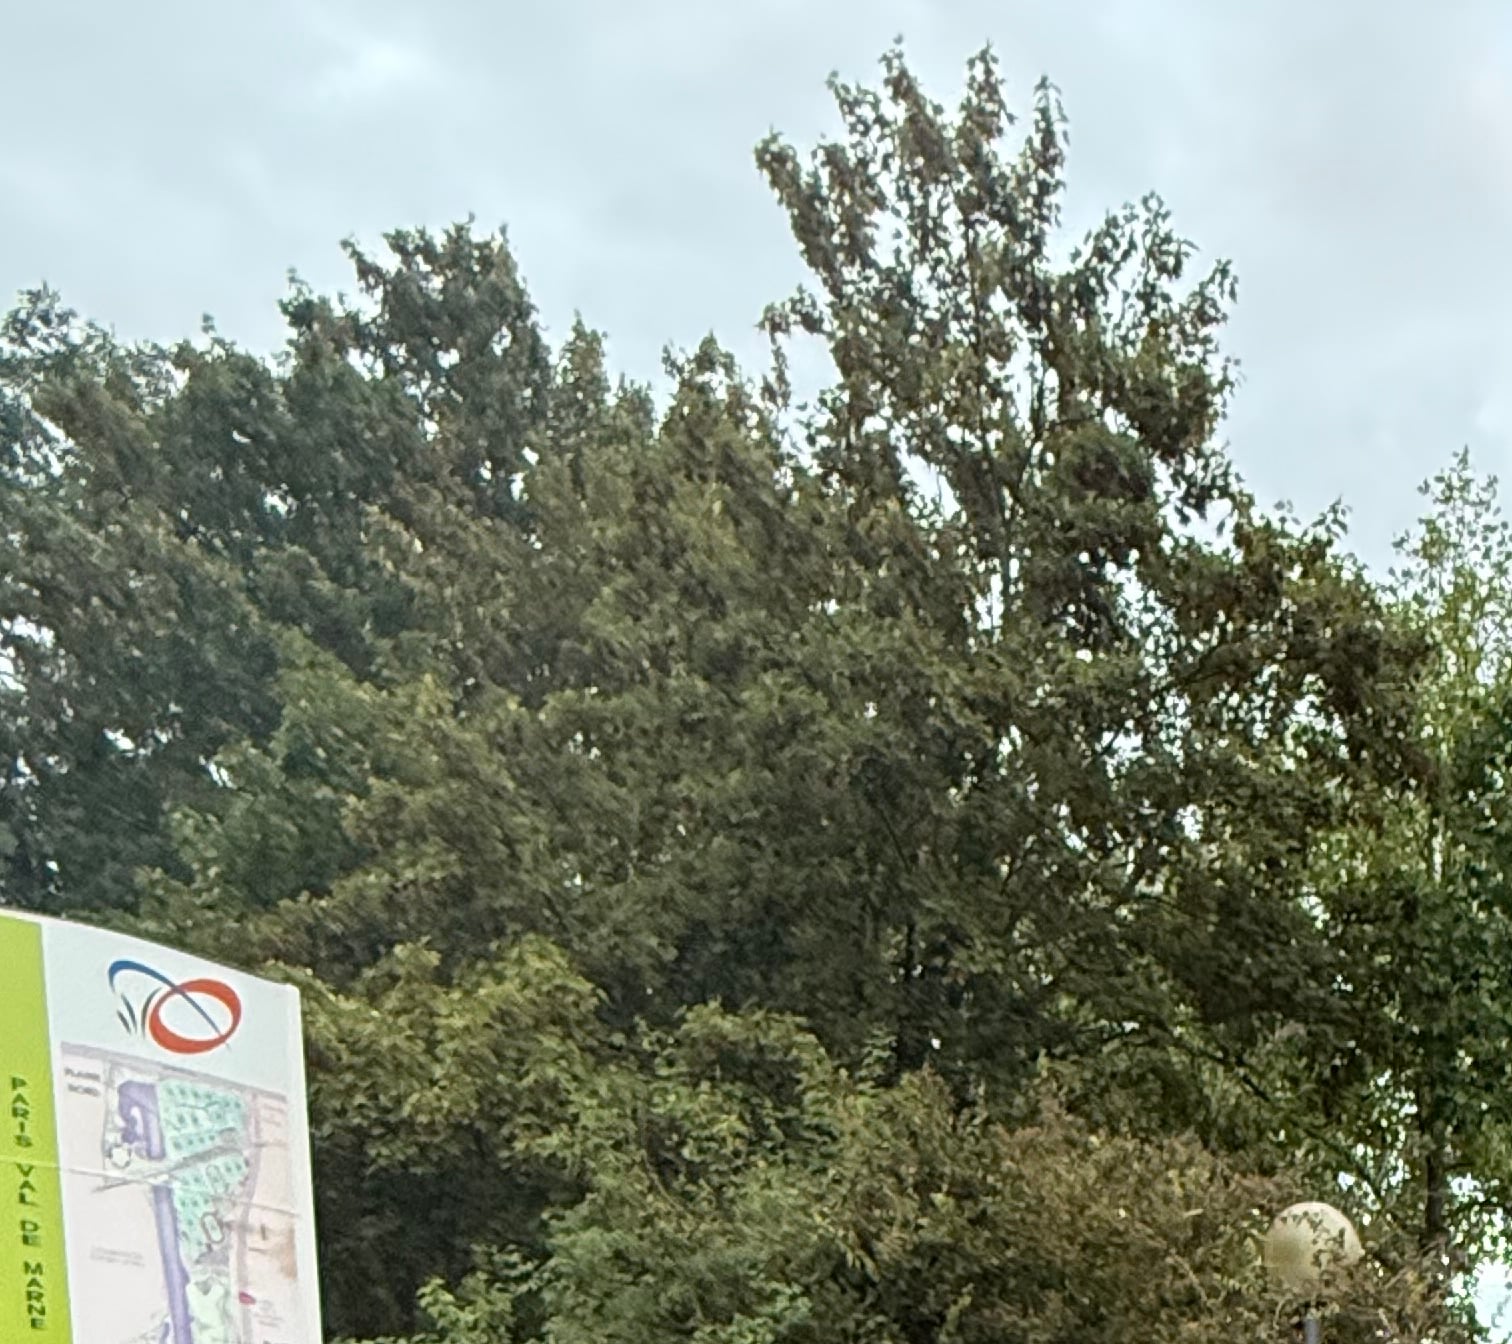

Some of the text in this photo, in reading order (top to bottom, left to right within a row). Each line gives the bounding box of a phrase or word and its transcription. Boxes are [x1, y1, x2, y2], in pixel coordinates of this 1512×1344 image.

[11, 1076, 46, 1330] PARIS VAL DE MARNE
